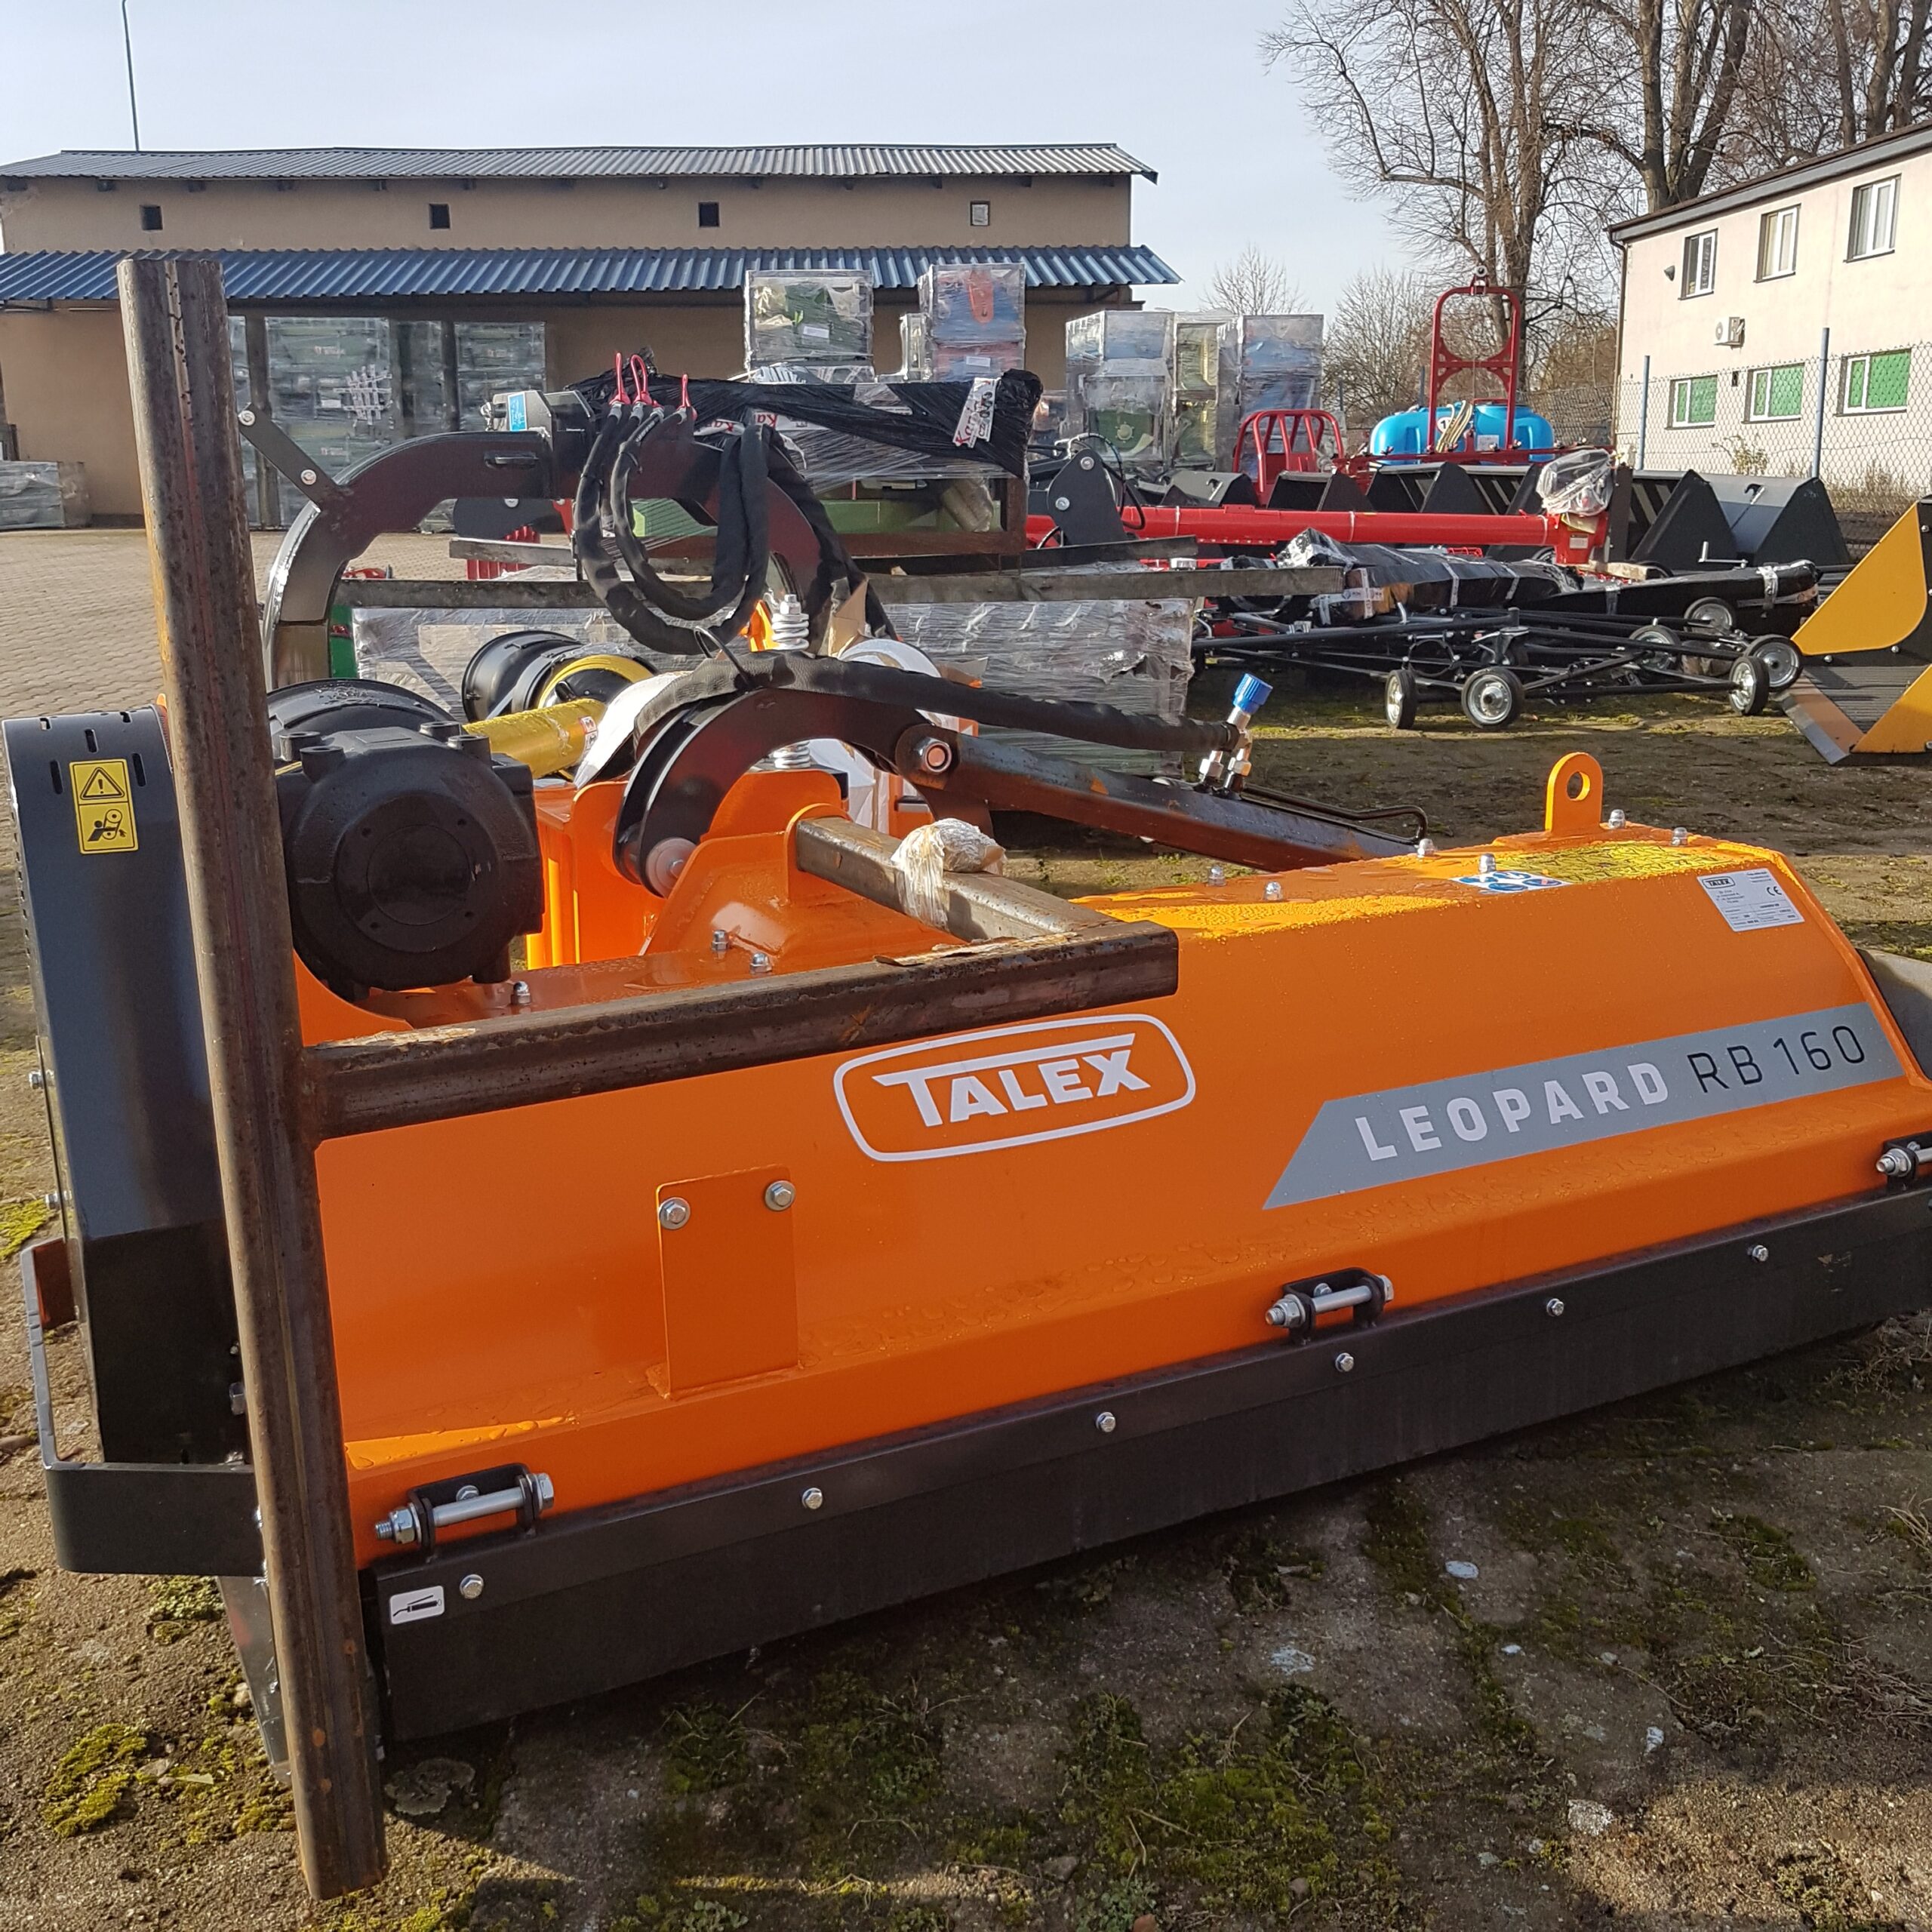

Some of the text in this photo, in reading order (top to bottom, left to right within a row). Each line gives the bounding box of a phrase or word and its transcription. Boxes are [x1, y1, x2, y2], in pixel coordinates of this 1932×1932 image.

[872, 1032, 1151, 1128] TALEX
[1355, 1026, 1866, 1162] LEOPARD RB 160
